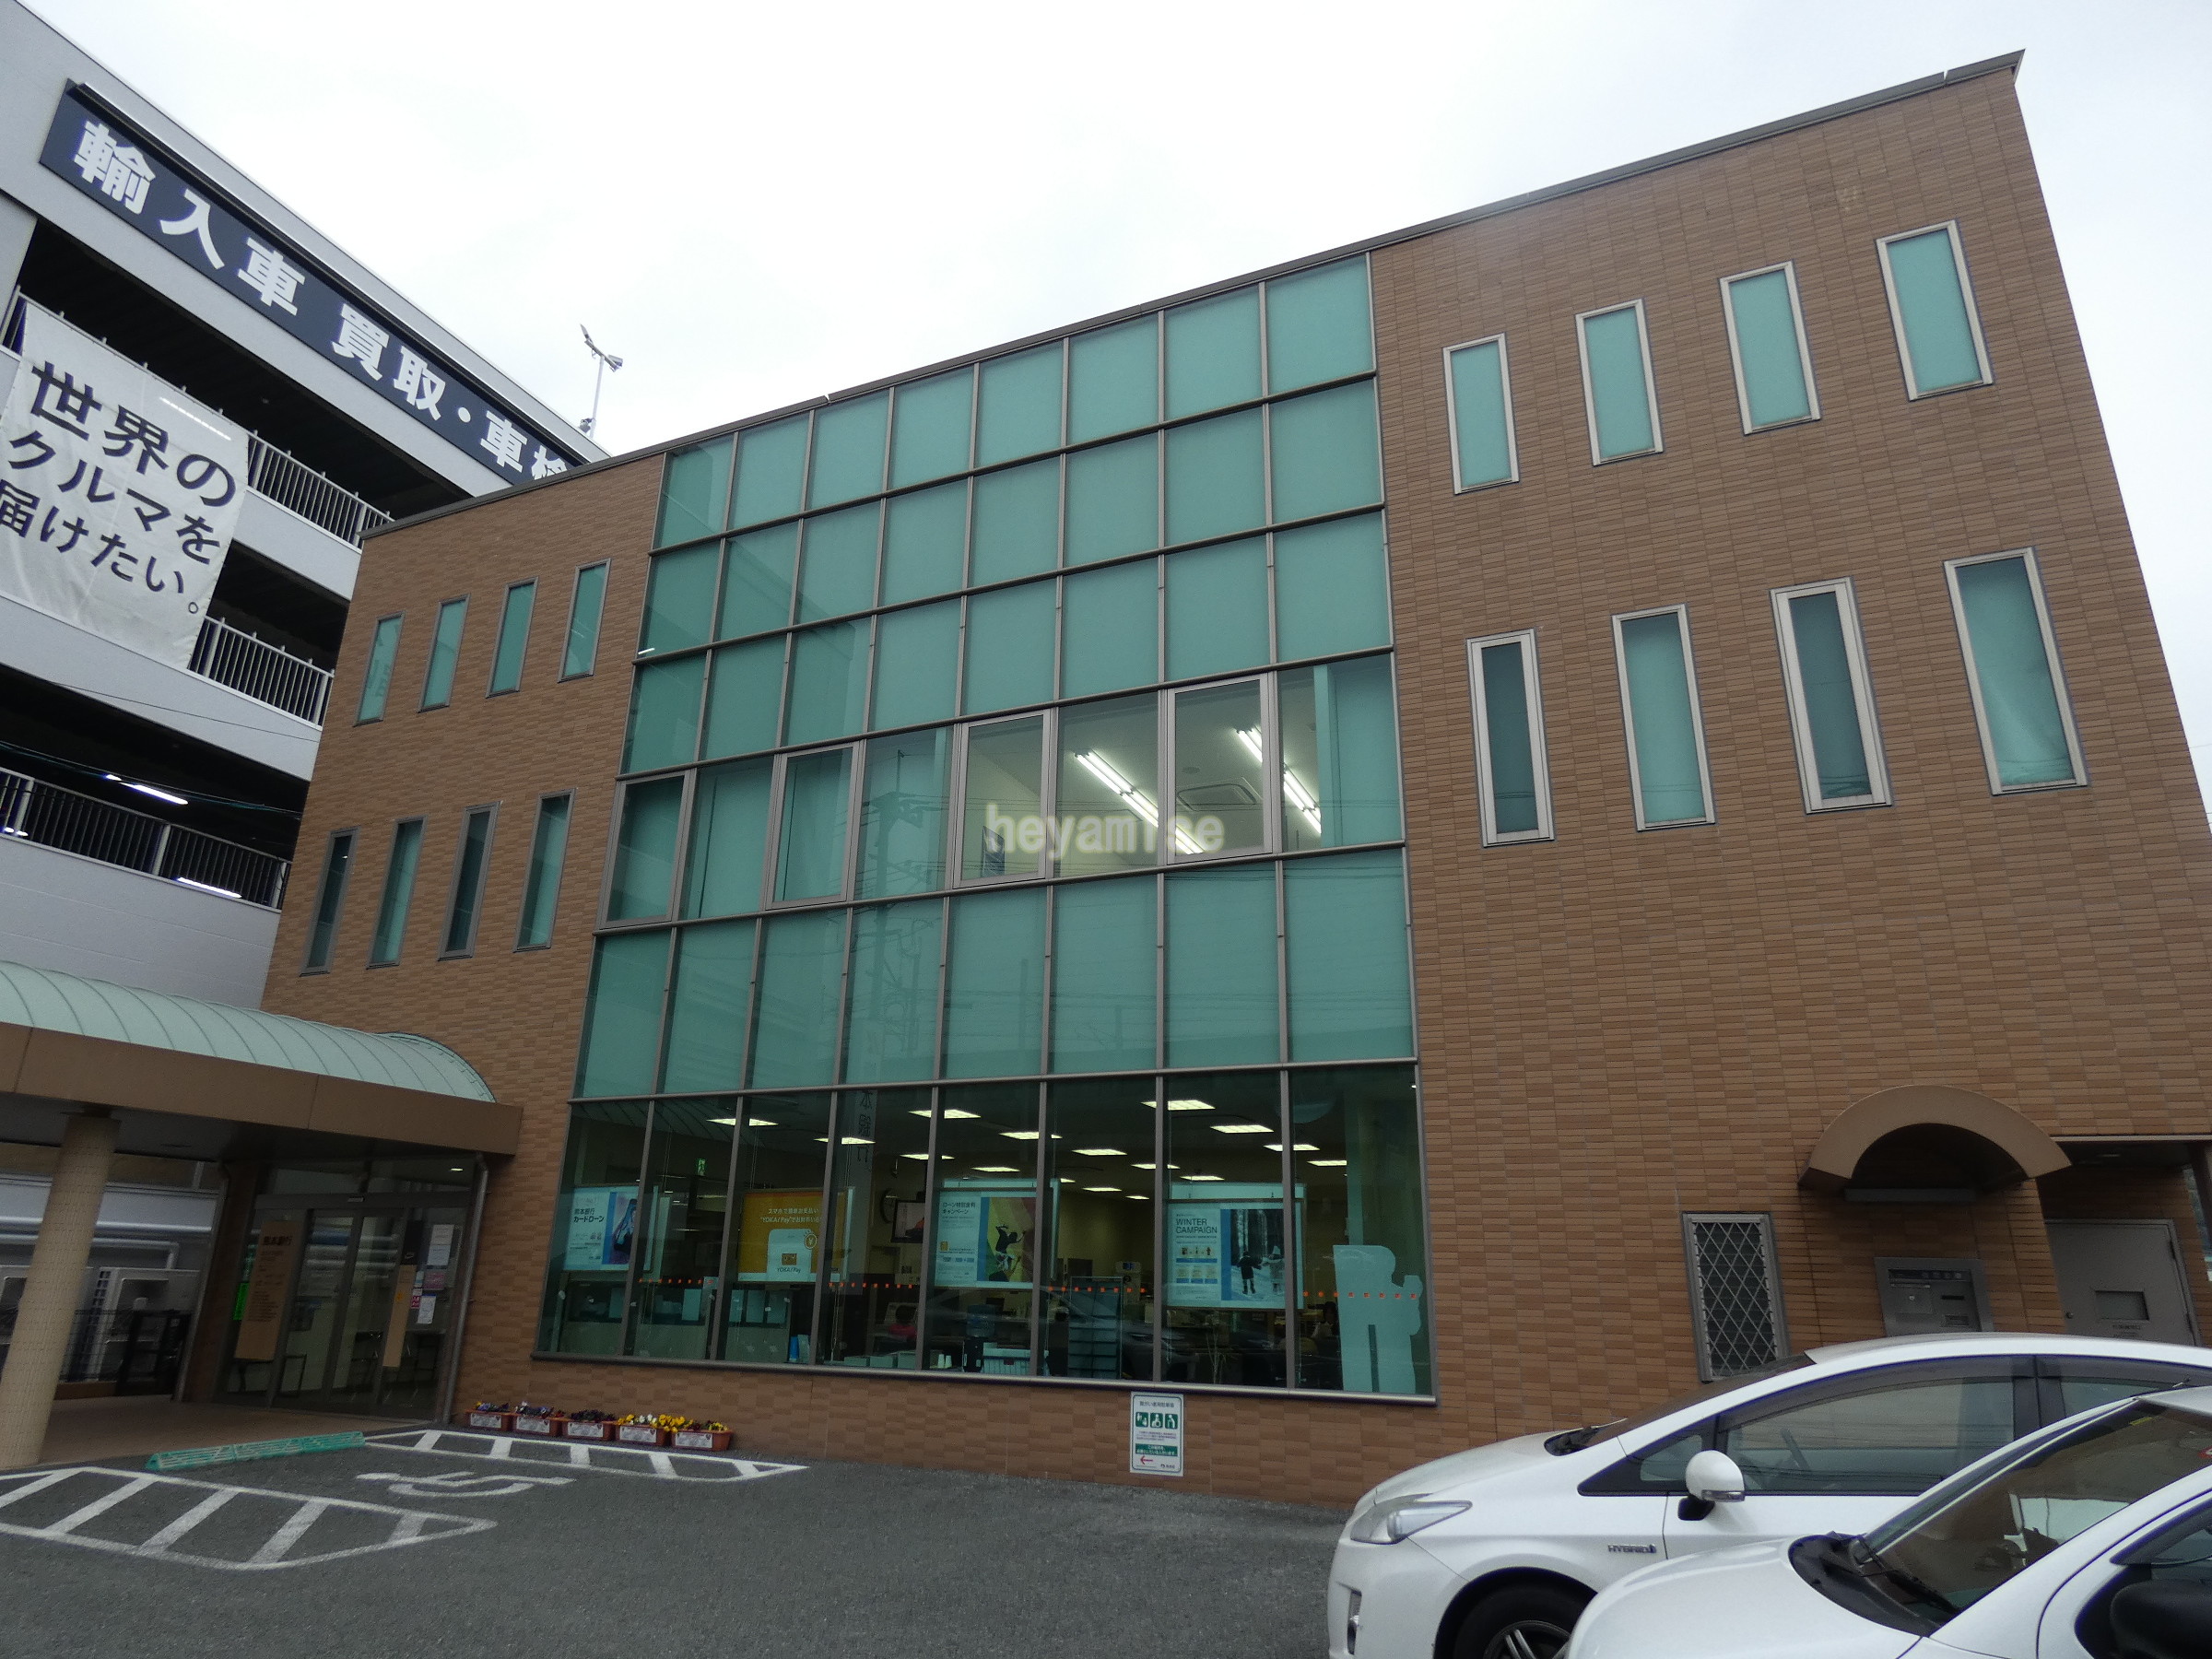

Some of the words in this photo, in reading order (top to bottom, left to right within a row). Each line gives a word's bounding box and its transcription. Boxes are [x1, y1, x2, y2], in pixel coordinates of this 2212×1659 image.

[74, 119, 306, 316] 輸入車
[30, 360, 236, 507] 世界の
[7, 429, 220, 565] クルマを
[1175, 1226, 1218, 1234] CAMPAIGN
[1176, 1218, 1207, 1226] WINTER
[1607, 1543, 1649, 1553] HYBRID
